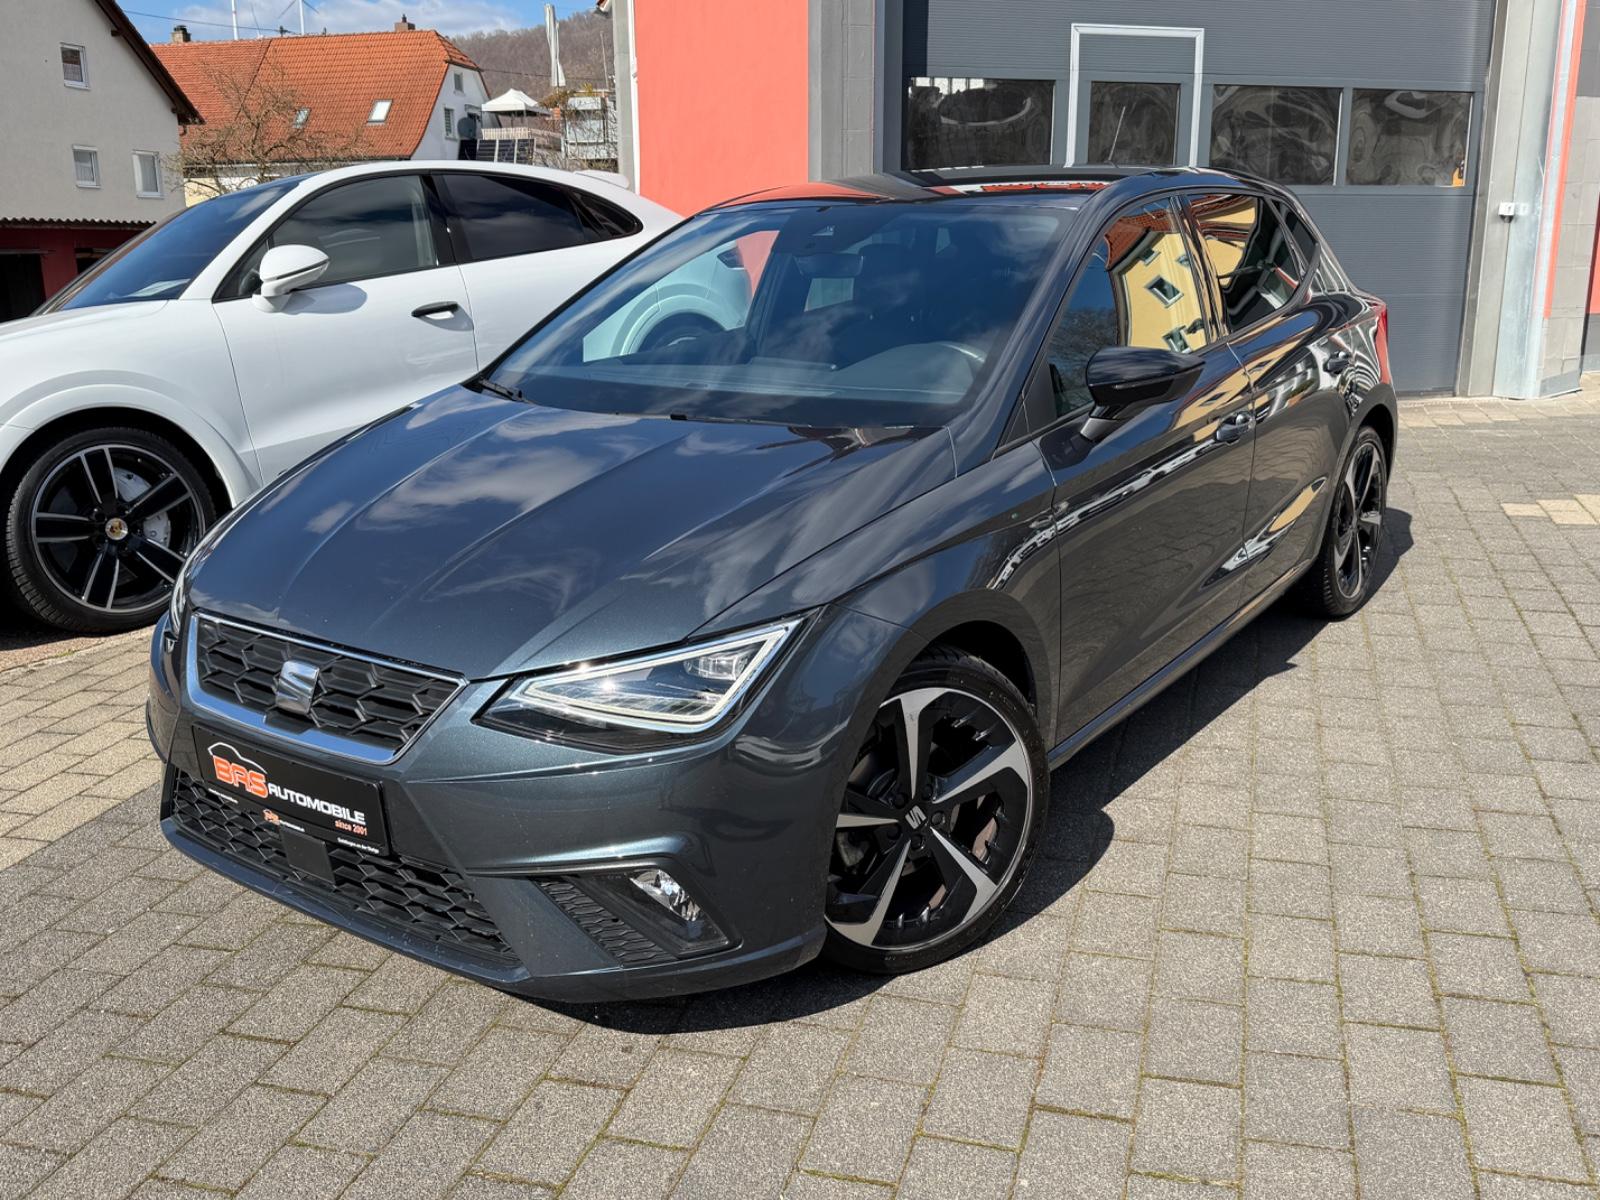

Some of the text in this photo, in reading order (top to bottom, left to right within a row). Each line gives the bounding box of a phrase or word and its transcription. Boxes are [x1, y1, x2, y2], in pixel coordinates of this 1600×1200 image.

[213, 755, 269, 799] BAS
[268, 783, 367, 825] AUTOMOBILE
[353, 824, 368, 836] 2001
